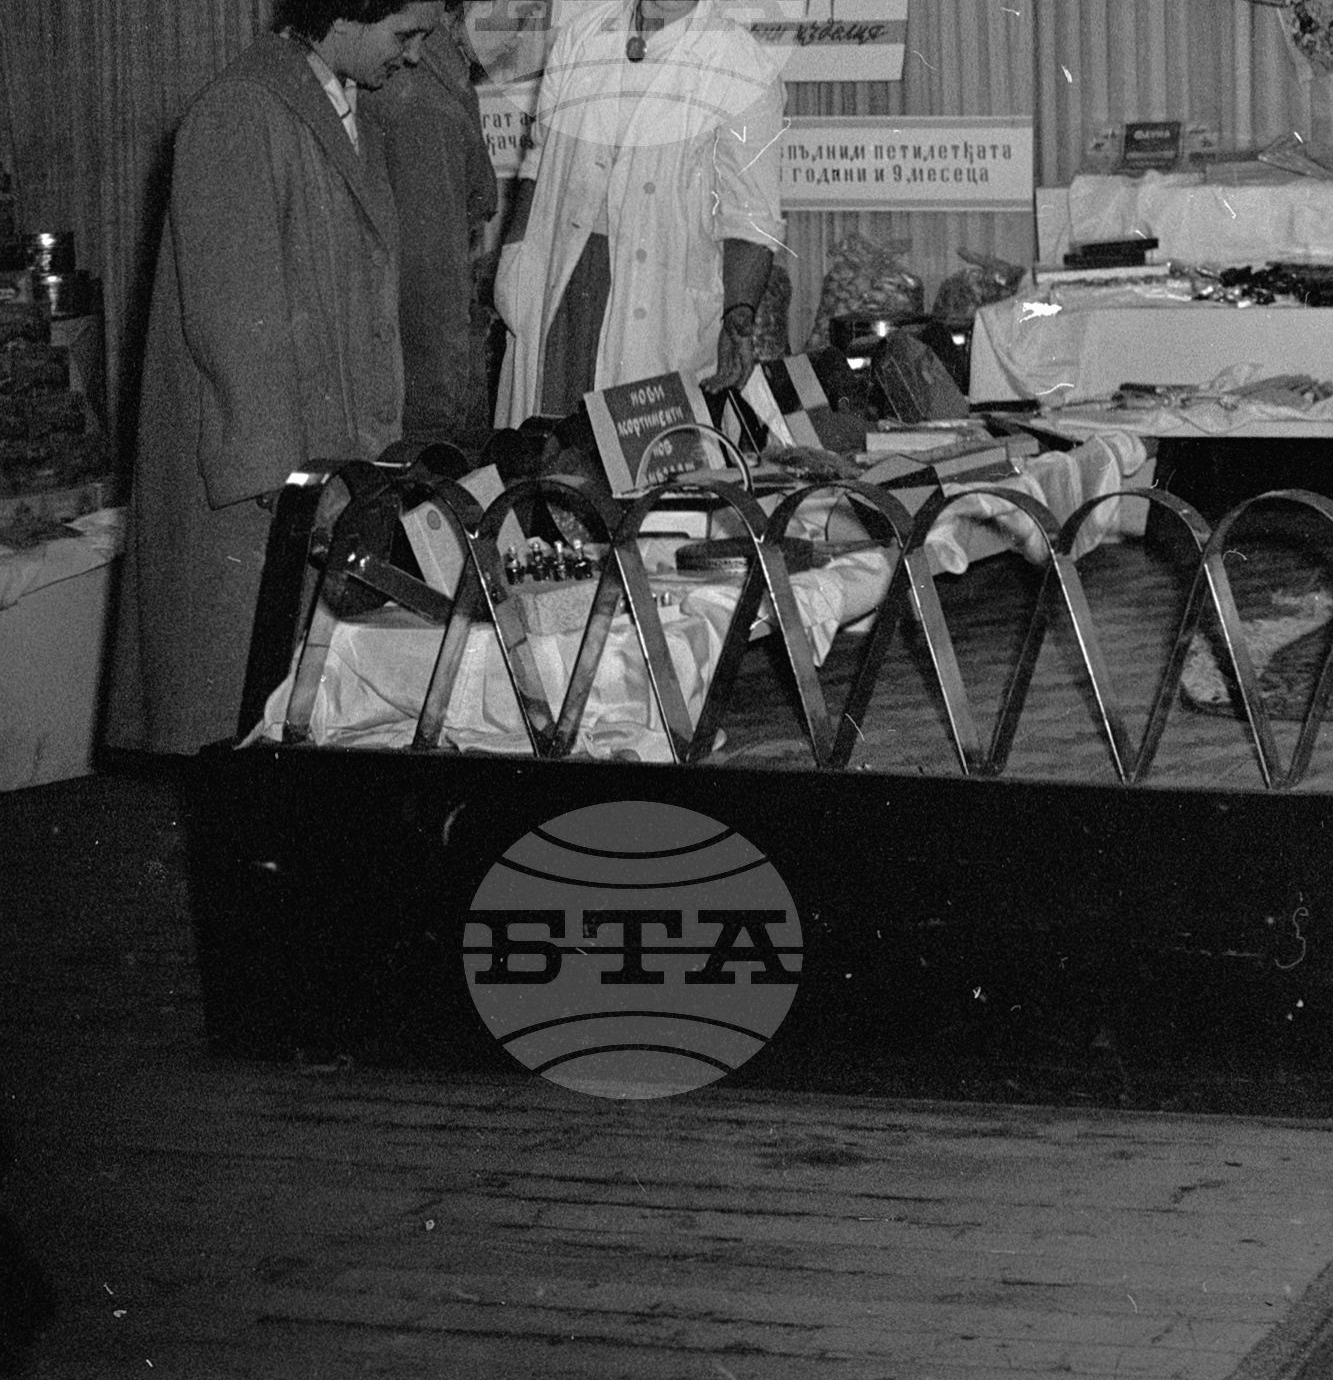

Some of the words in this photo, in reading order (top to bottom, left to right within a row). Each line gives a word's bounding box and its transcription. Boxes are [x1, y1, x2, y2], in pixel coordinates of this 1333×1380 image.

[482, 113, 512, 129] гат
[873, 142, 1012, 164] петилетката
[792, 167, 867, 184] години
[874, 167, 885, 182] и
[892, 164, 903, 182] 9
[906, 167, 990, 185] месеца
